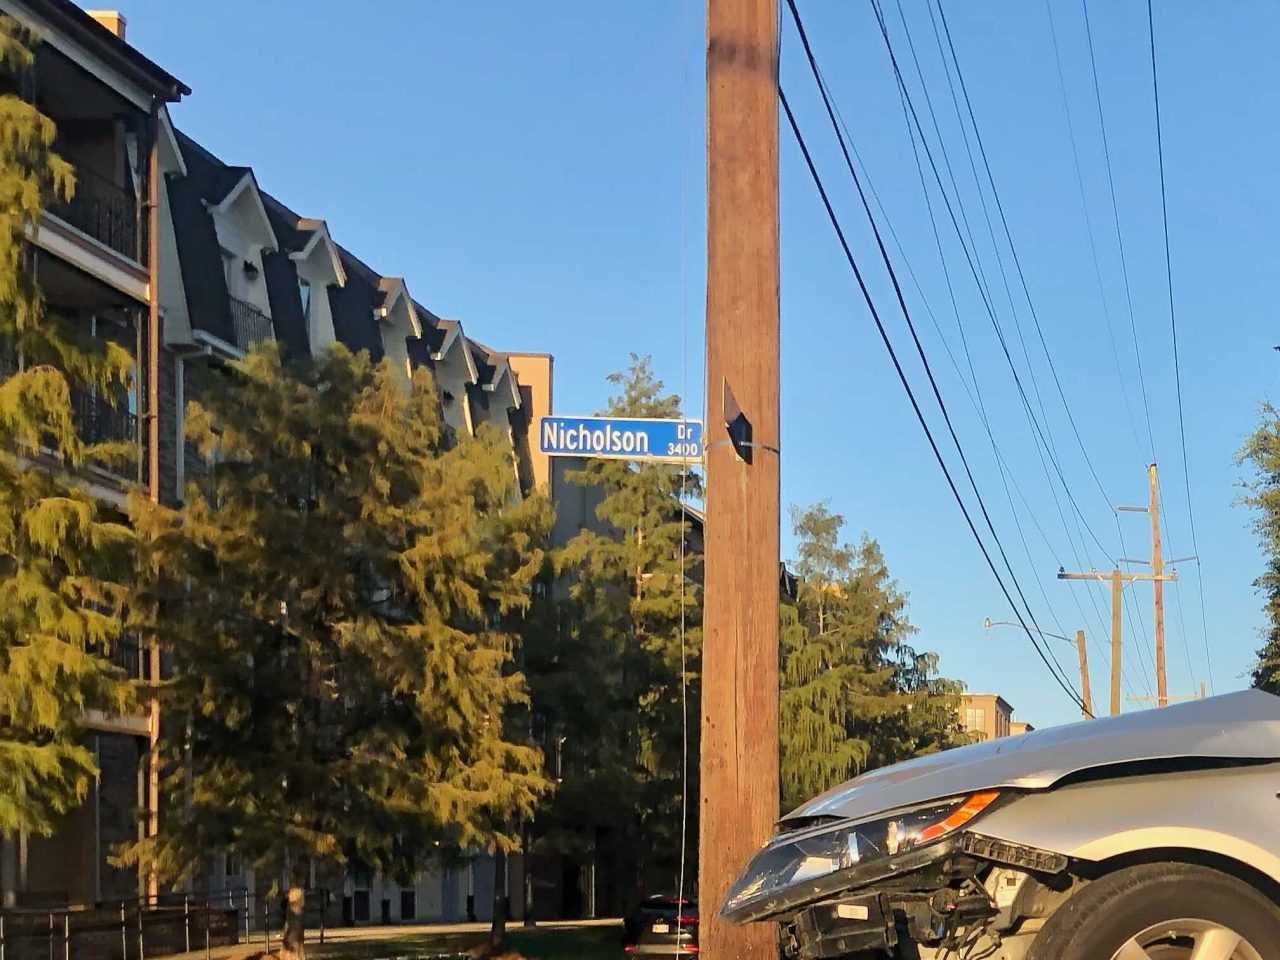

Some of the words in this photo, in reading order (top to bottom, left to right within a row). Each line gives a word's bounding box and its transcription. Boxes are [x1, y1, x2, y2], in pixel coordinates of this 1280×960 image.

[543, 422, 649, 453] Nicholson
[677, 424, 693, 441] Dr
[667, 442, 698, 456] 3400
